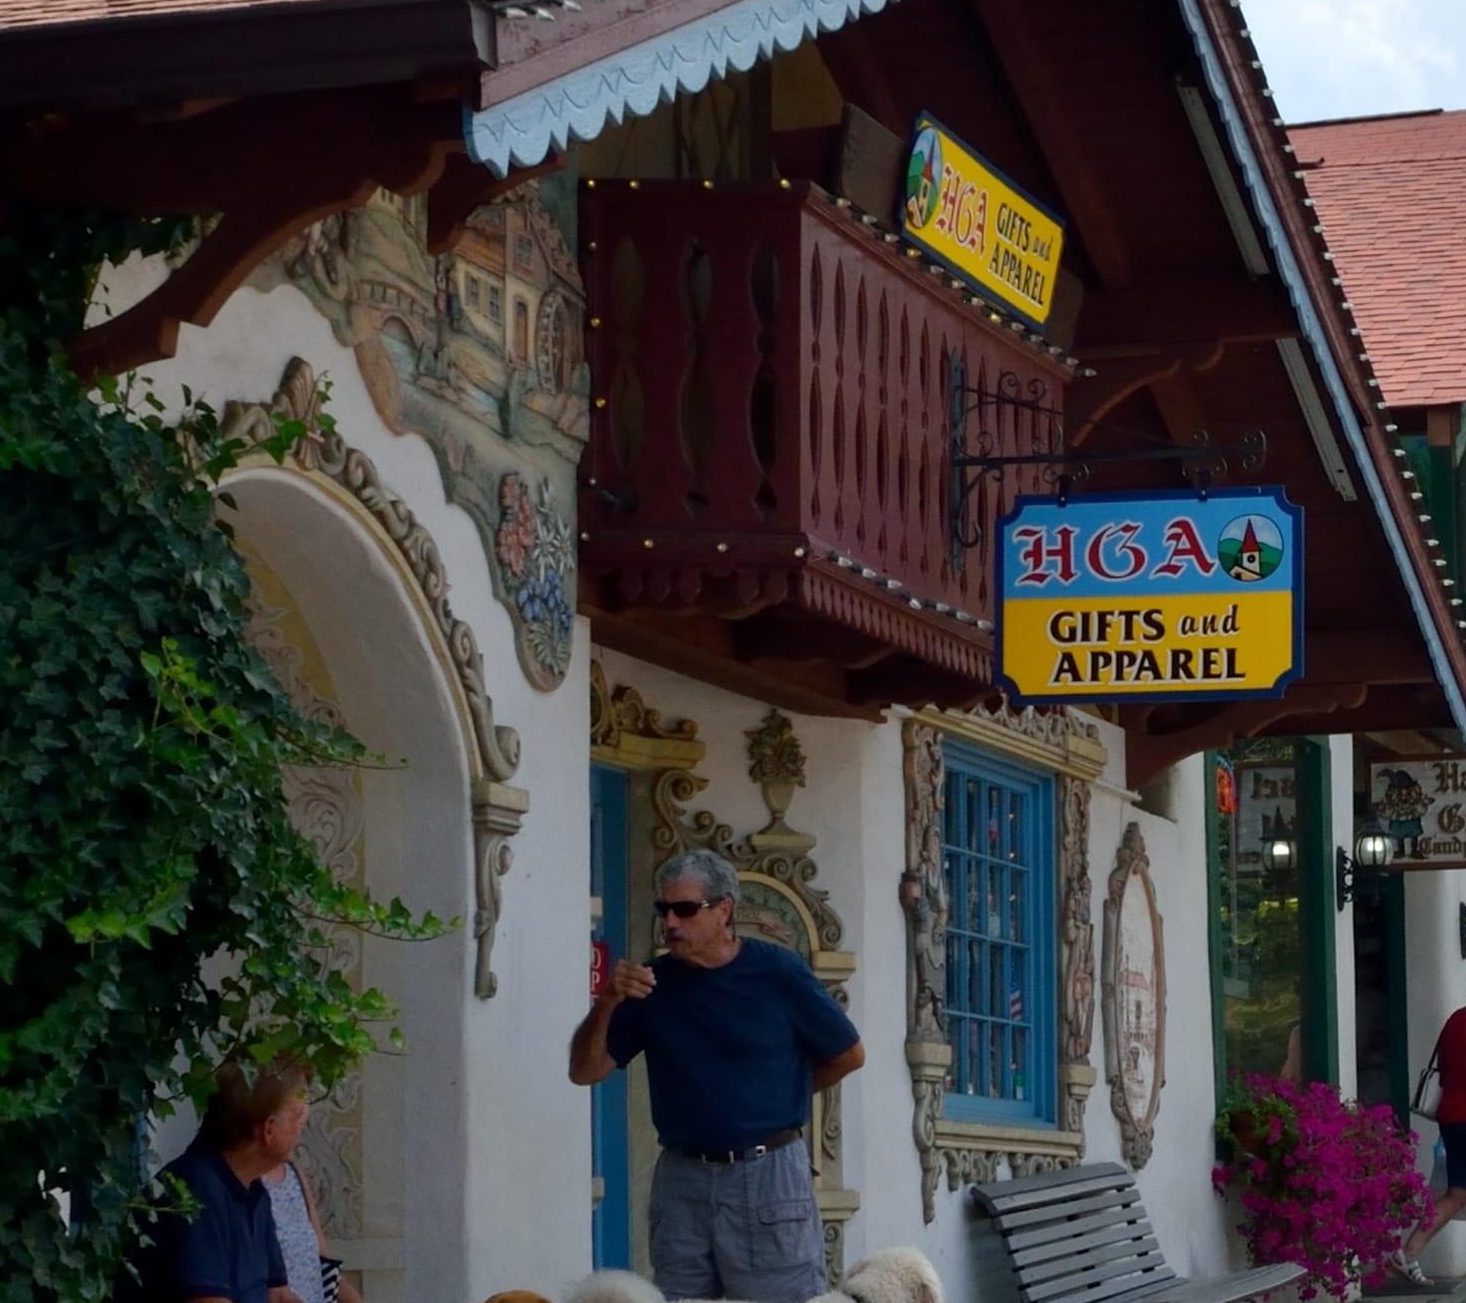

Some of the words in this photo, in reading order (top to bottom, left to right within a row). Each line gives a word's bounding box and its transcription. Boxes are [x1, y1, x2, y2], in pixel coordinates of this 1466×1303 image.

[936, 164, 988, 258] HGA
[996, 202, 1032, 254] GIFTS
[1031, 236, 1054, 263] and
[987, 241, 1046, 308] APPAREL
[1012, 516, 1218, 588] HGA
[1047, 608, 1166, 646] GIFTS
[1178, 603, 1242, 636] and
[1048, 647, 1247, 685] APPAREL
